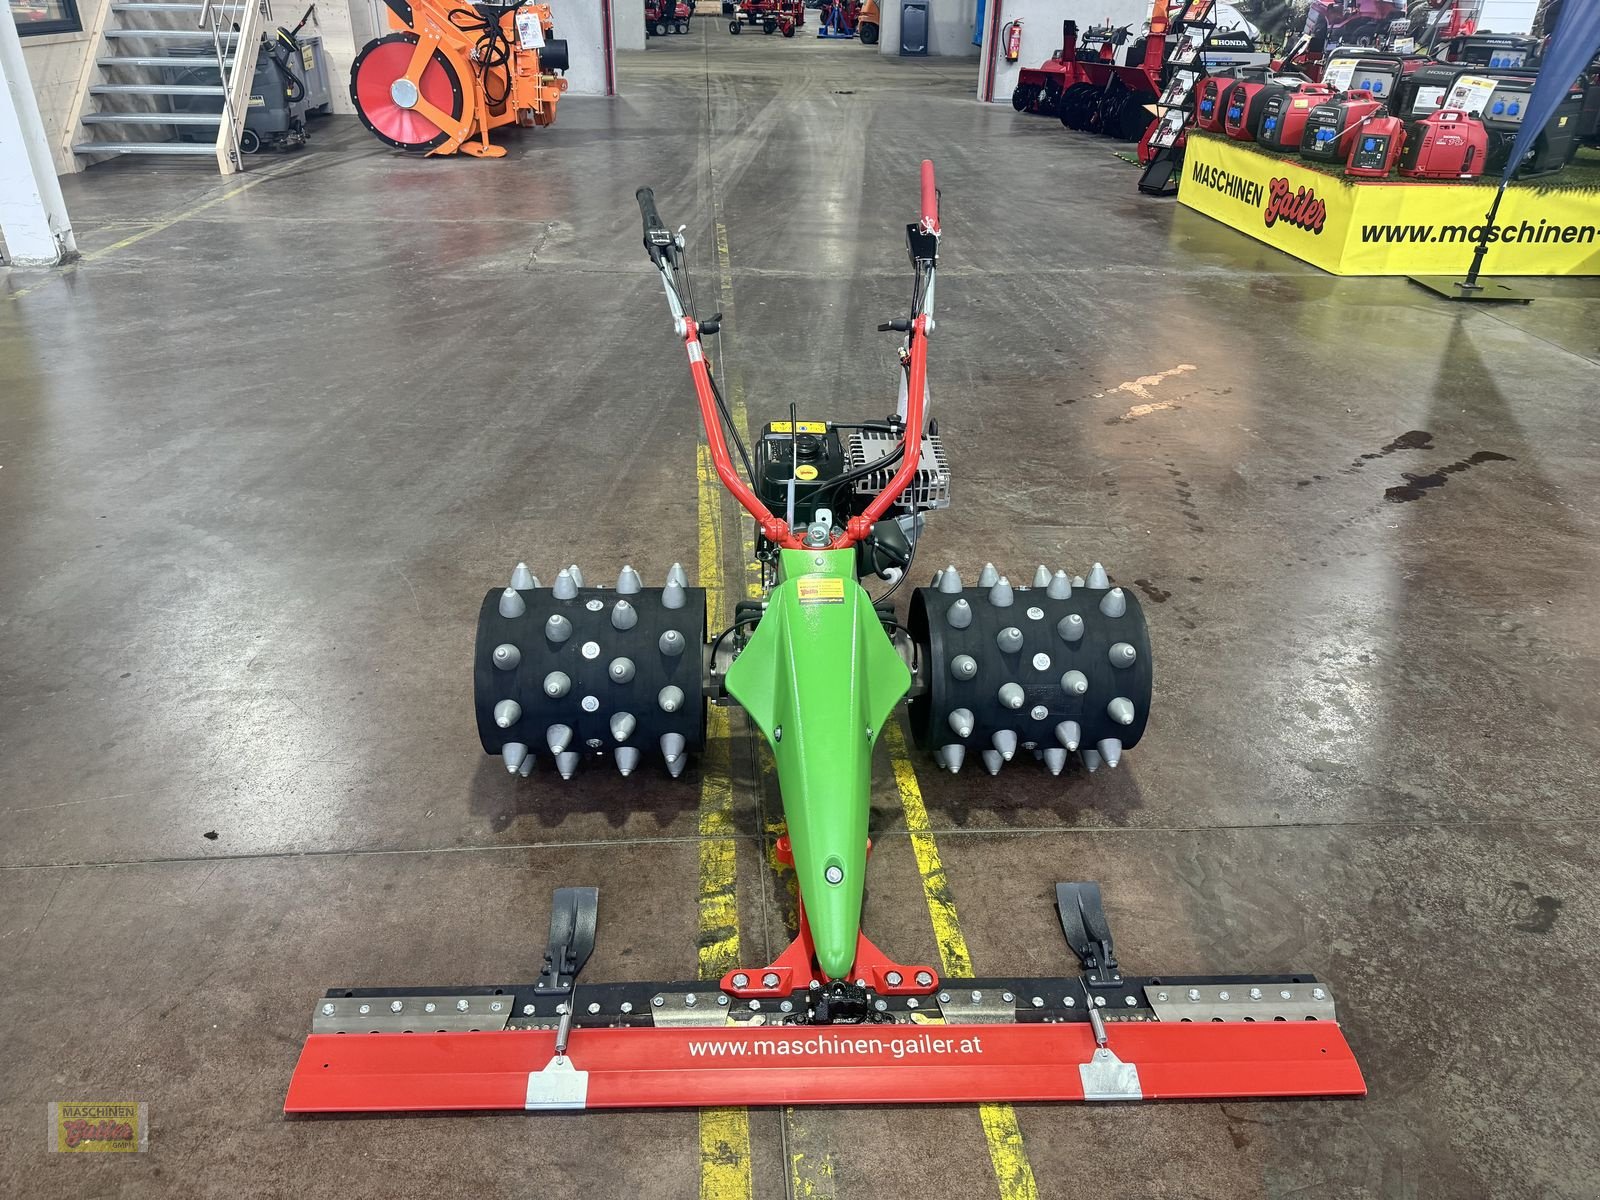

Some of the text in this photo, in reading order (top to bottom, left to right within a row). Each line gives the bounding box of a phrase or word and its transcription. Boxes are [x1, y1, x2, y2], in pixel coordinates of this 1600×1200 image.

[1192, 161, 1327, 235] MASCHINEN Gailer
[688, 1034, 983, 1058] www.maschinen-gailer.at
